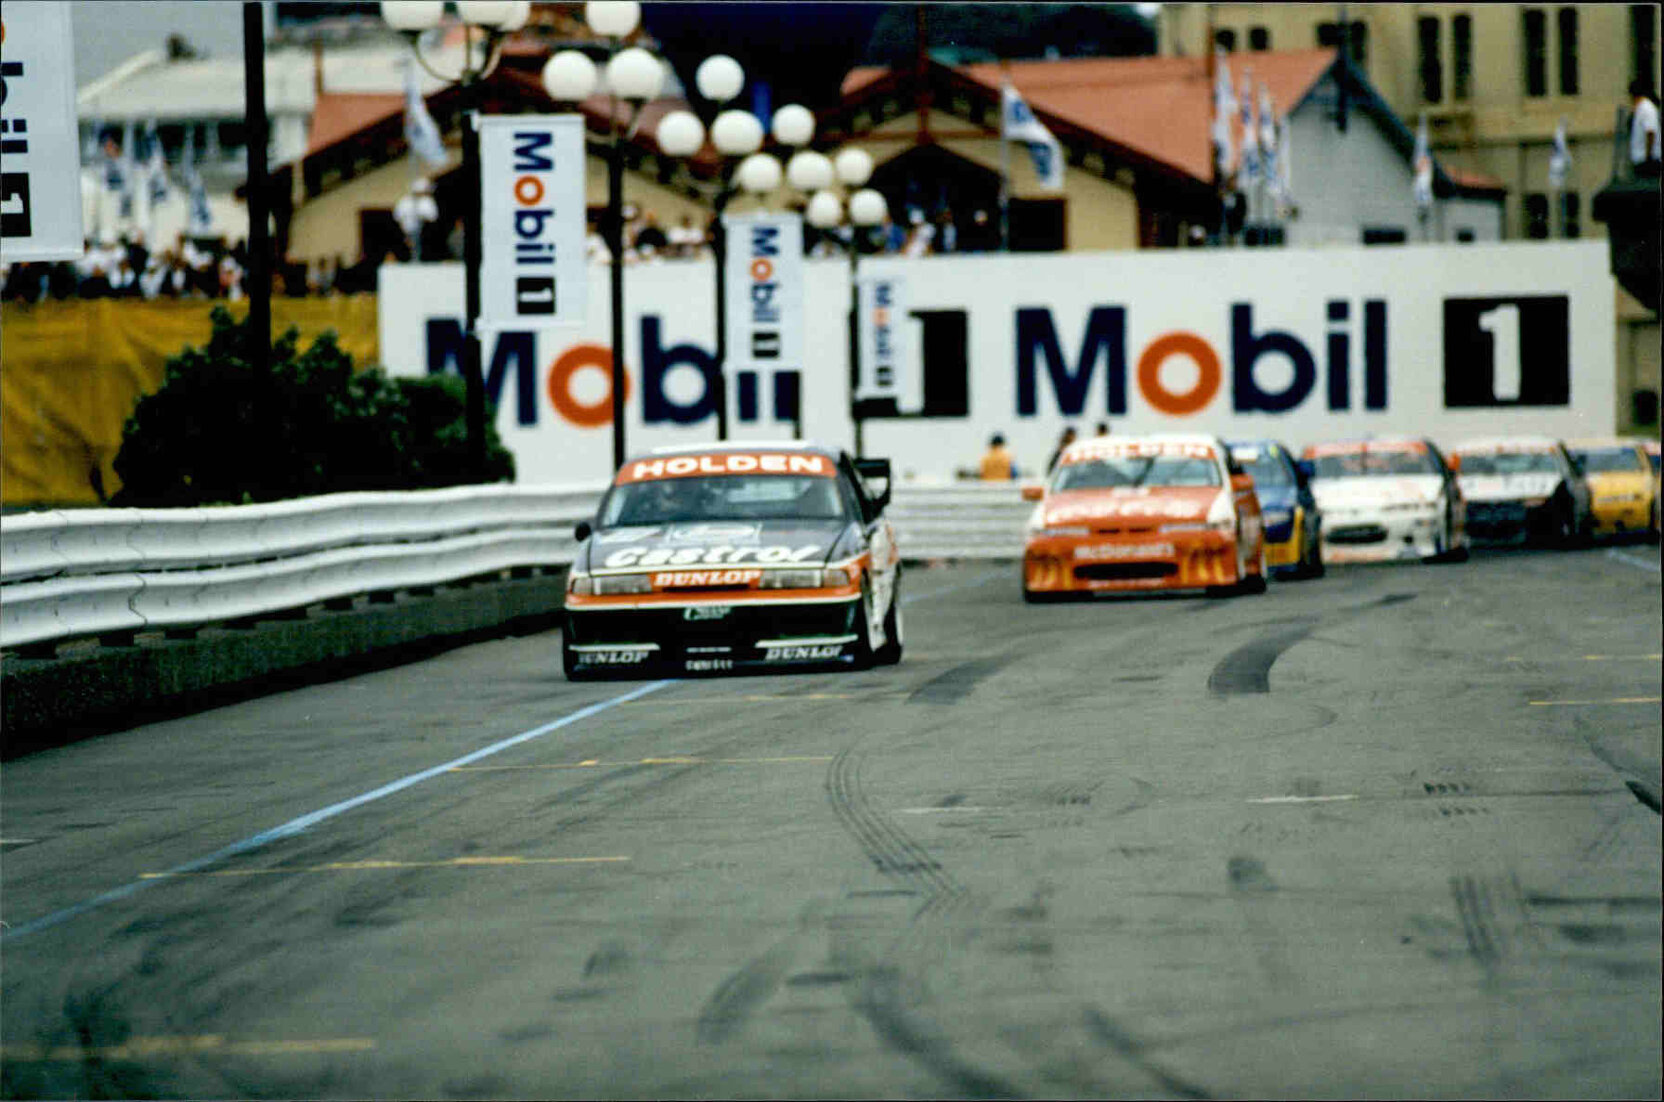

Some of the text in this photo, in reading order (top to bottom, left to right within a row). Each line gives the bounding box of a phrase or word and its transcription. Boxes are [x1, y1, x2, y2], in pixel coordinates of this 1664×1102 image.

[514, 132, 555, 264] Mobil
[752, 227, 780, 322] Mobil
[1015, 299, 1388, 417] Mobil
[633, 455, 823, 478] HOLDEN
[604, 544, 820, 568] Castrol
[654, 570, 762, 586] DUNLOP
[765, 646, 843, 660] DUNLOP
